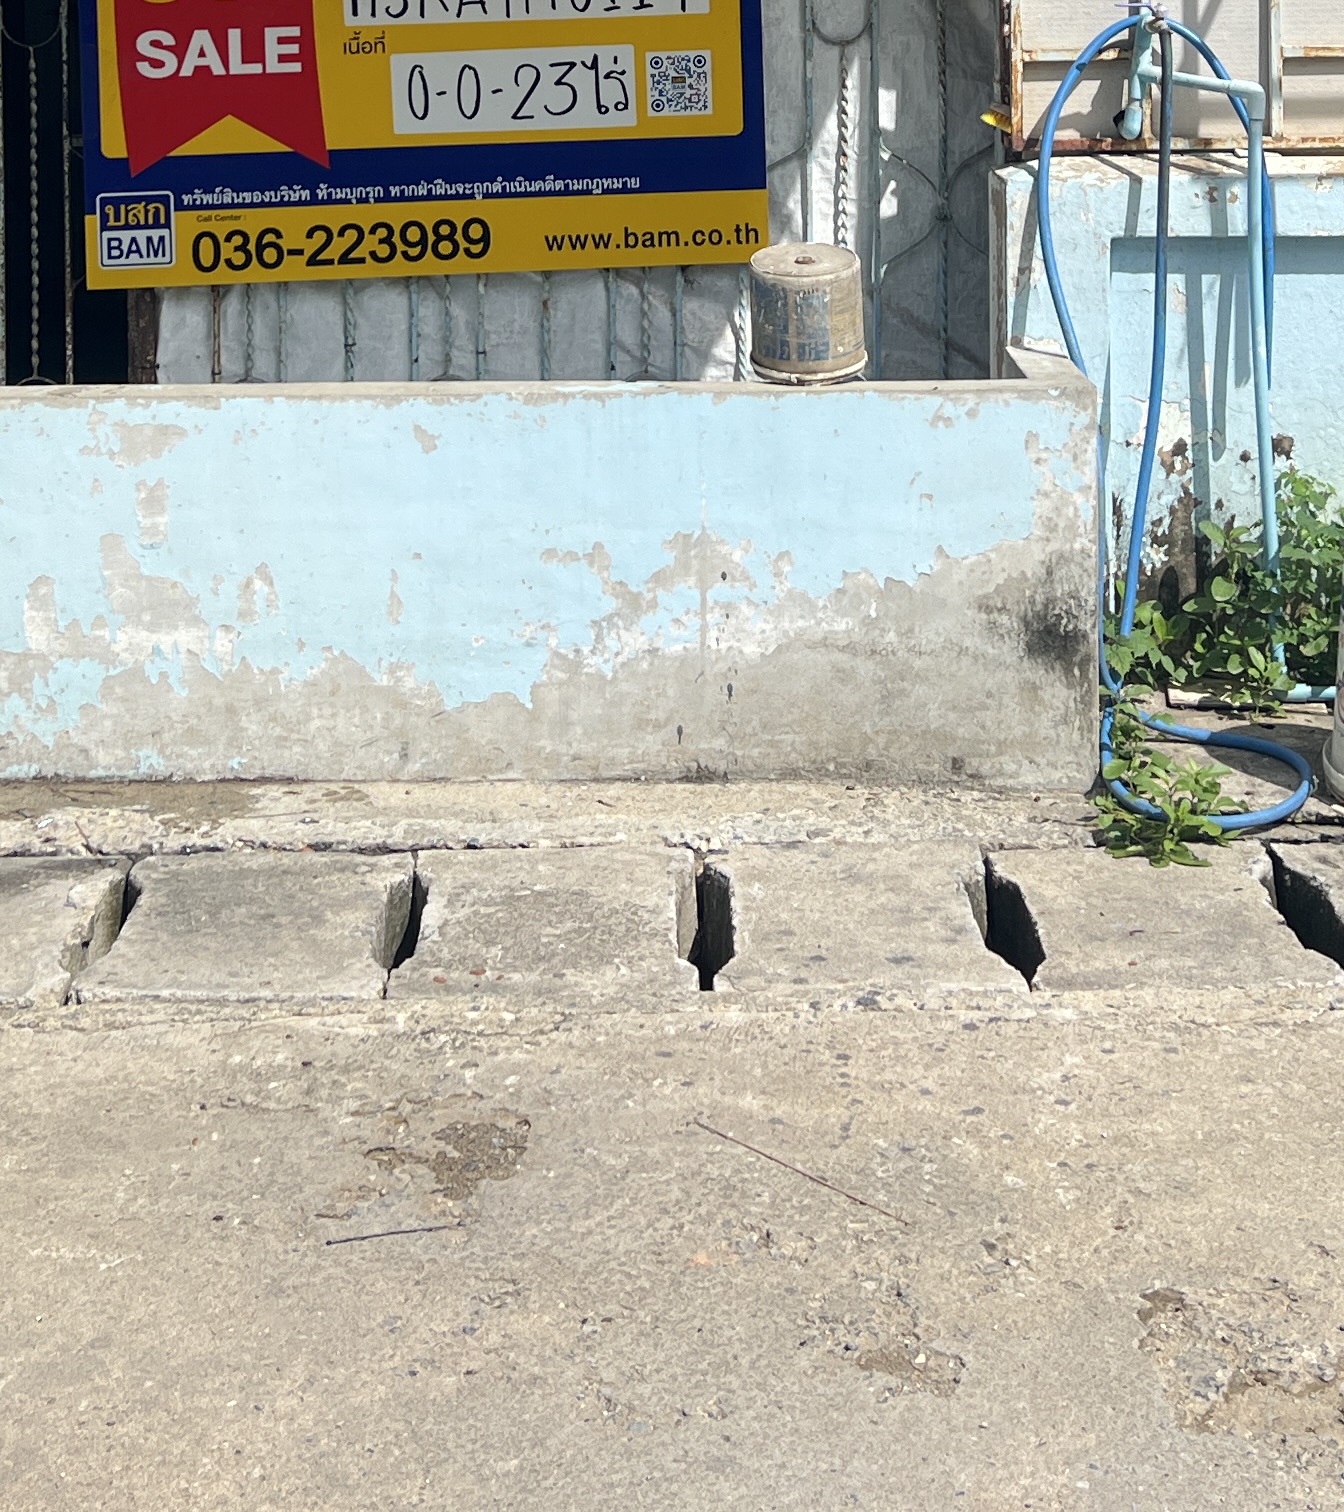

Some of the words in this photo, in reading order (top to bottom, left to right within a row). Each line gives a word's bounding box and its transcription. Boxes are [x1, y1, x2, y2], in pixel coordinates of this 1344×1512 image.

[135, 26, 303, 79] SALE
[343, 31, 386, 55] เนื้อที่
[181, 185, 311, 206] ทรัพย์สินของบริษัท
[316, 183, 384, 205] ห้ามบุกรุก
[105, 200, 166, 227] บสก
[106, 235, 167, 261] BAM
[191, 216, 492, 273] 036-223989
[544, 222, 760, 252] www.bam.co.th
